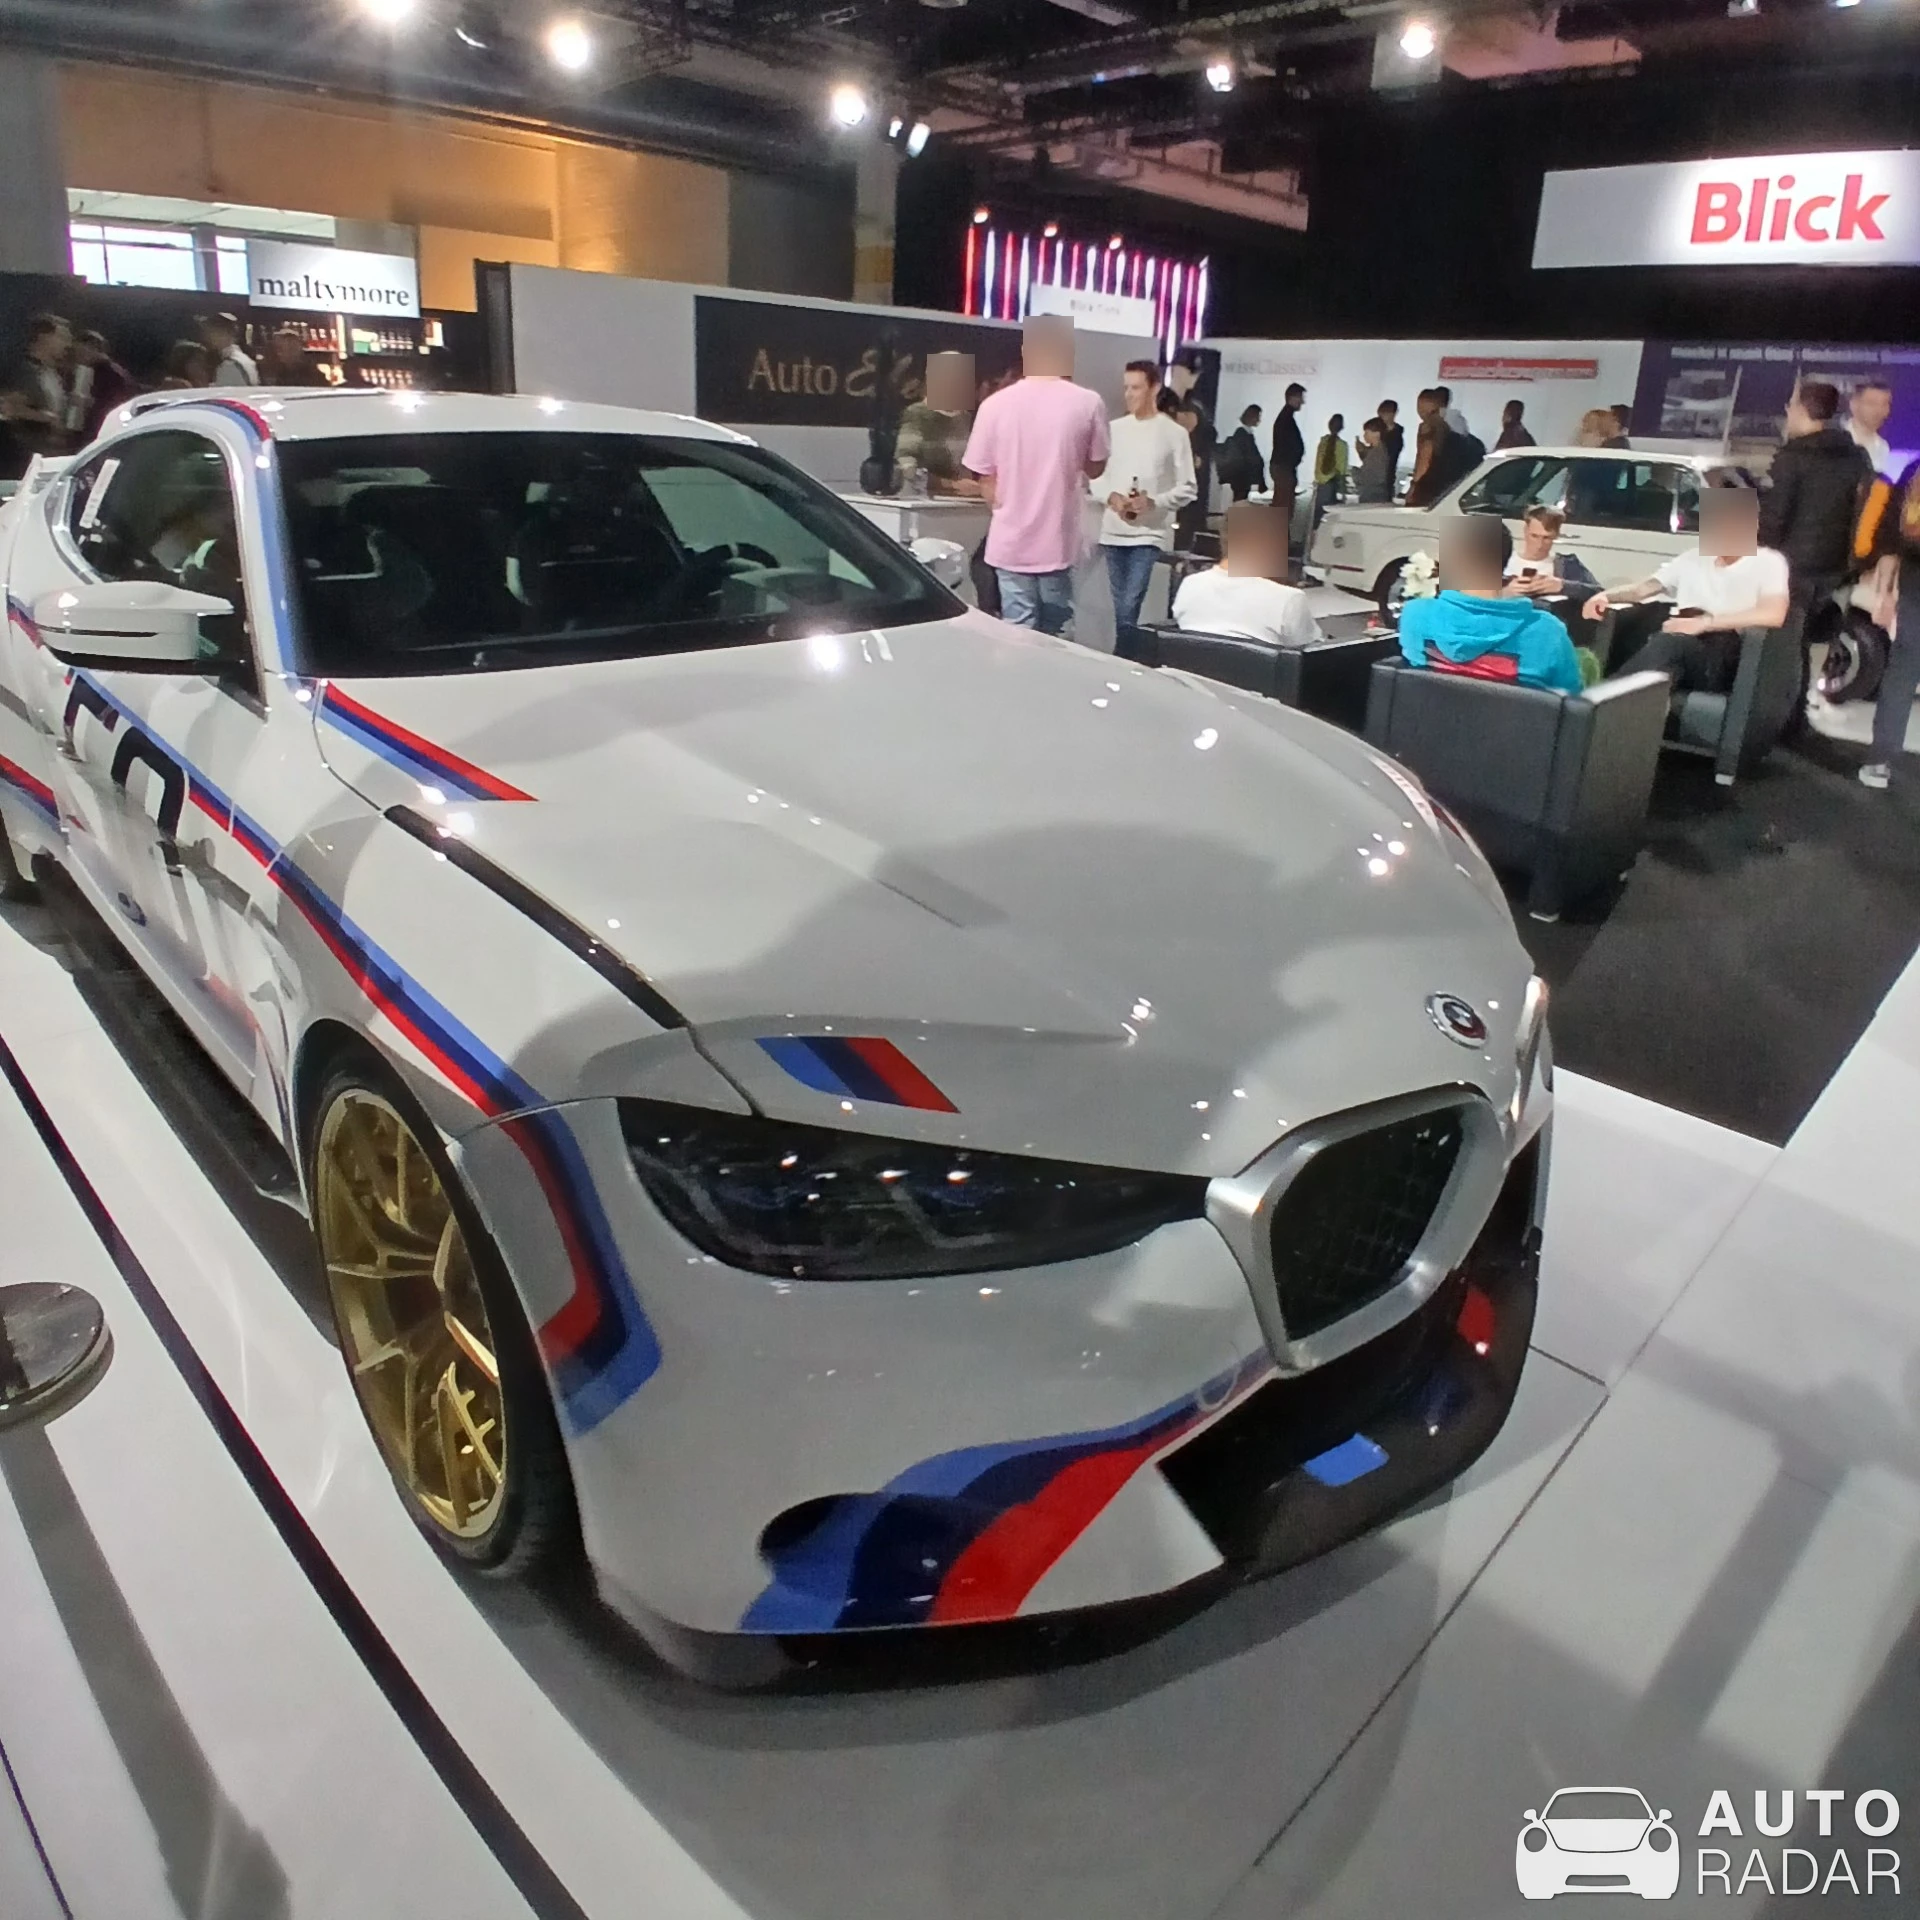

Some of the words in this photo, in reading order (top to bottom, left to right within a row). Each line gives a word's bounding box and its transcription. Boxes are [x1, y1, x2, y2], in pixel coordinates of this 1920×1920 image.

[1690, 174, 1891, 244] Blick
[257, 274, 410, 306] maltymore
[748, 348, 837, 396] Auto
